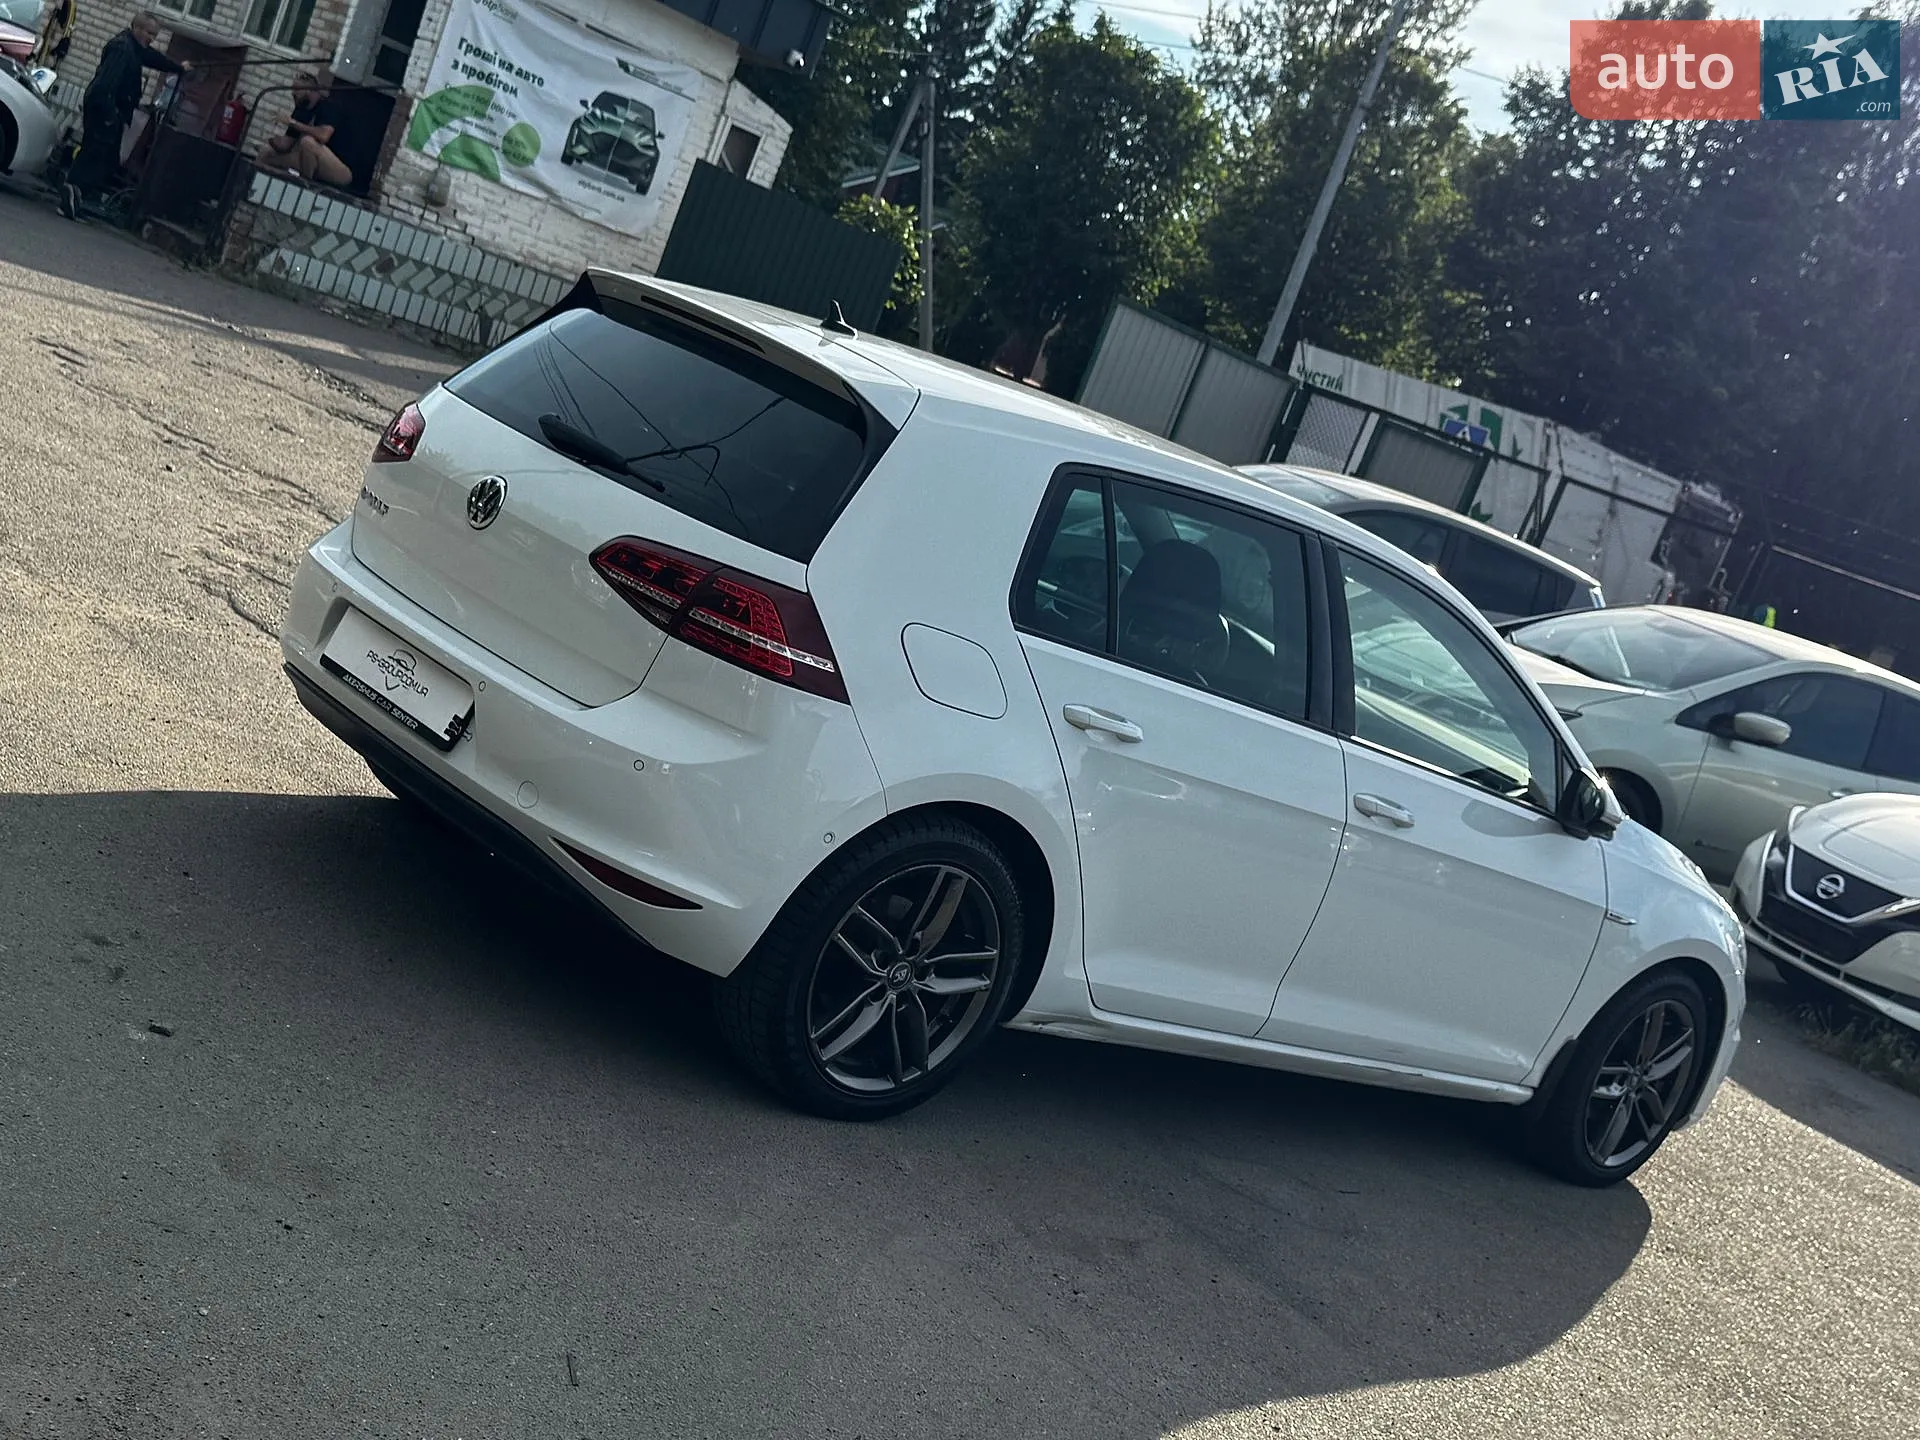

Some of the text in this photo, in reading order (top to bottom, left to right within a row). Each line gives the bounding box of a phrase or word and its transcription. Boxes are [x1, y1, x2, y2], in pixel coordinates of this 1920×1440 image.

[458, 36, 545, 88] Гроші на авто
[460, 62, 519, 99] пробігом
[376, 697, 392, 712] CAR
[390, 707, 419, 730] SENTER
